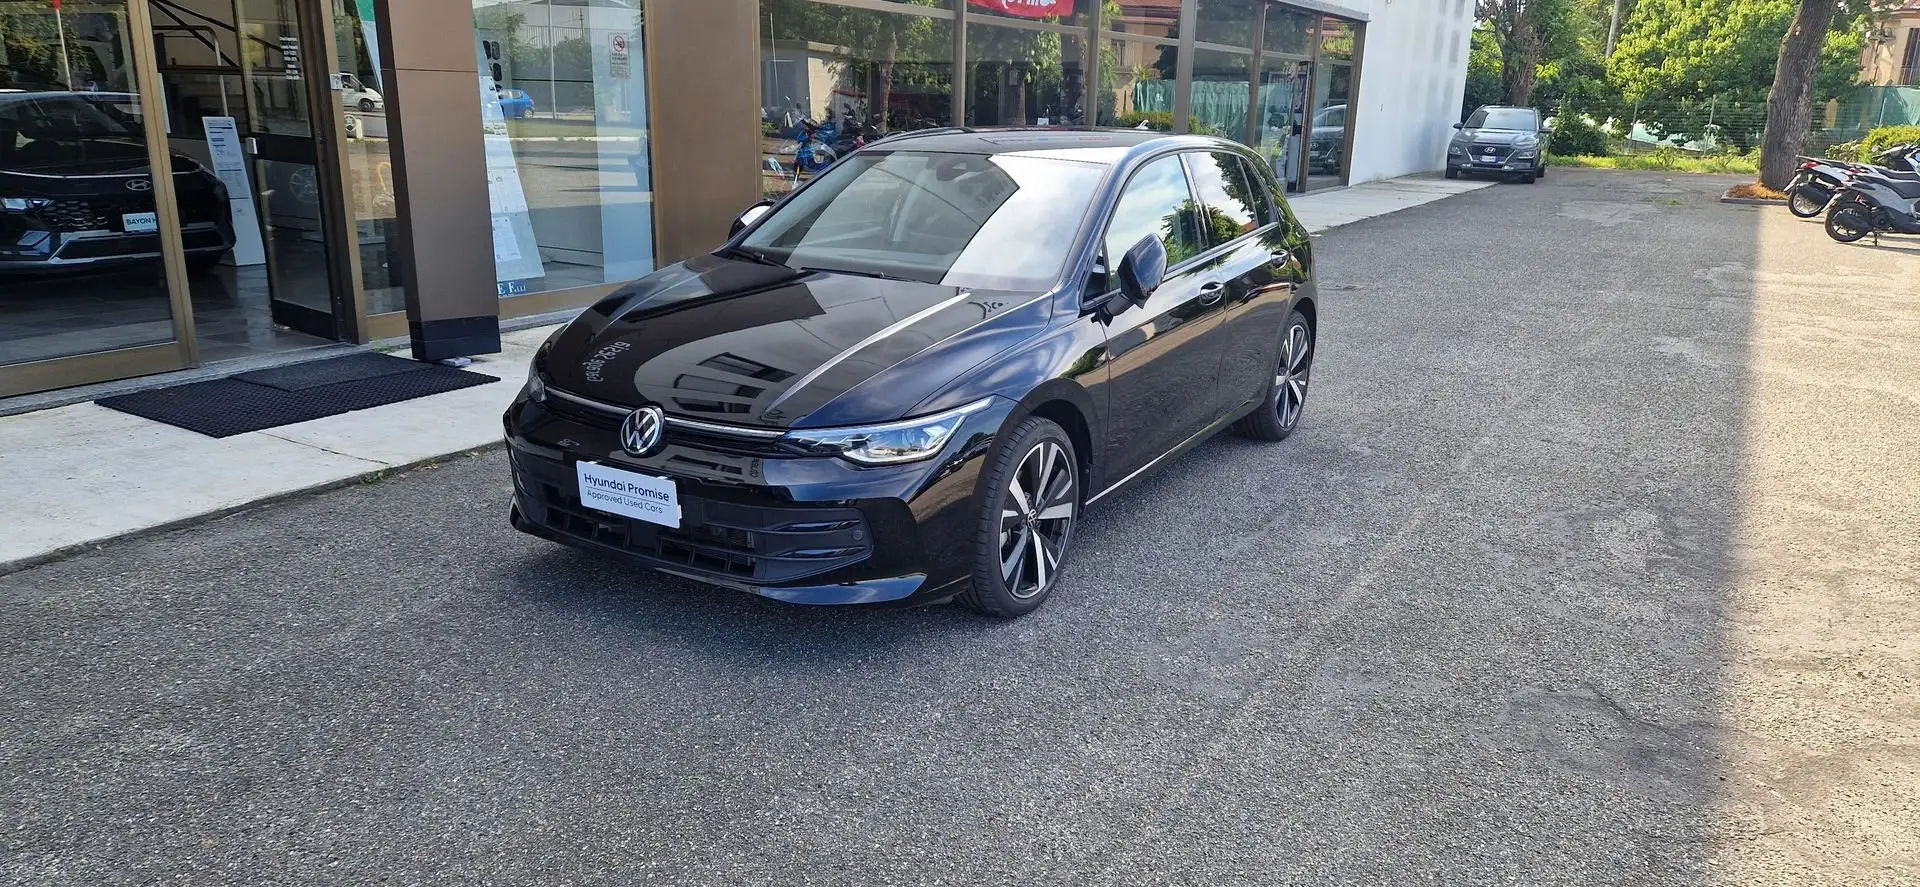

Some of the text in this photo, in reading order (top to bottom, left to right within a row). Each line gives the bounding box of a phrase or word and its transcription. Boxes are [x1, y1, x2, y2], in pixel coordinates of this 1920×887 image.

[584, 473, 670, 502] Hyundai Promise
[586, 489, 663, 514] Approved Used Cars
